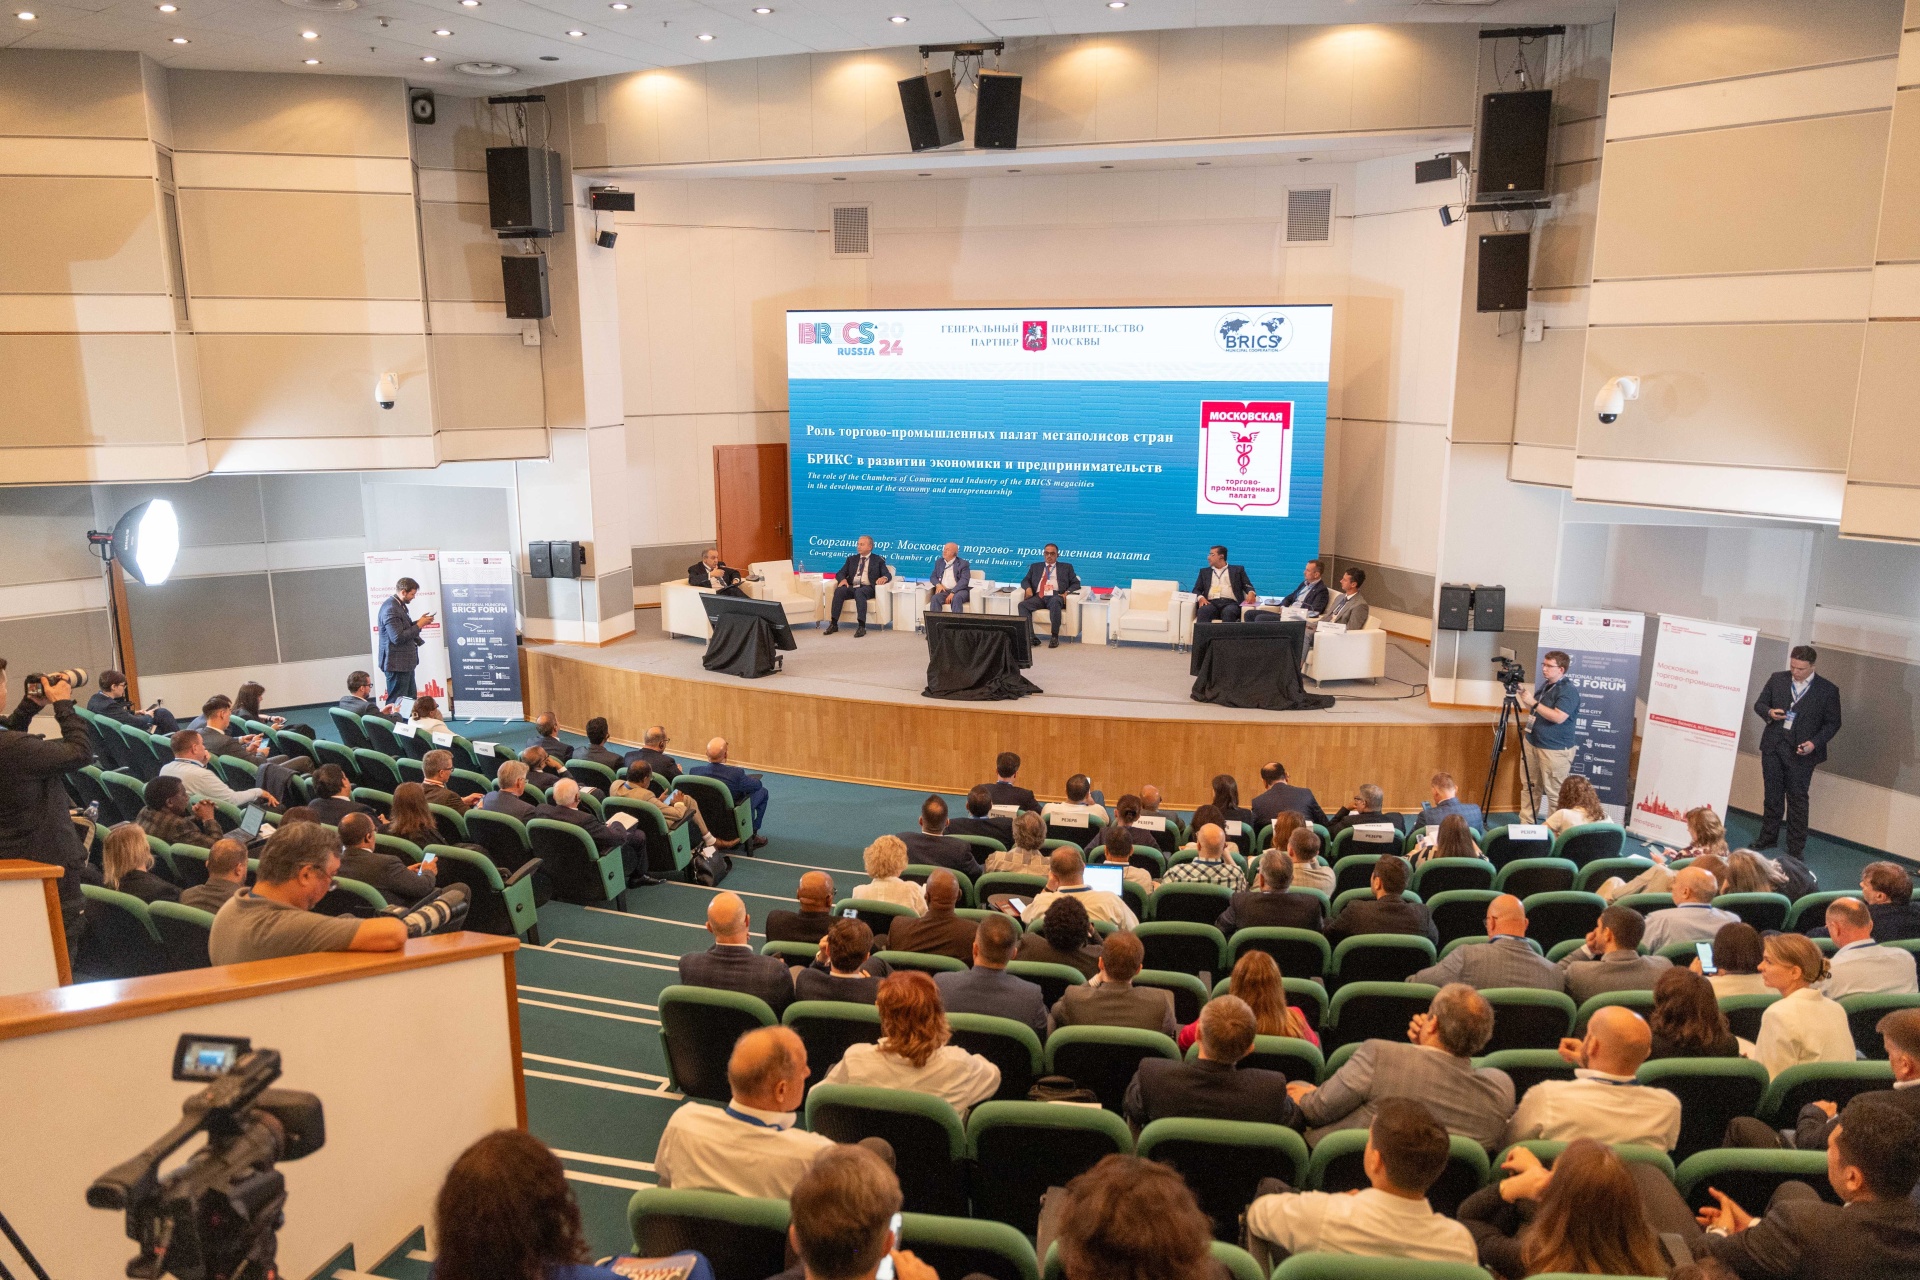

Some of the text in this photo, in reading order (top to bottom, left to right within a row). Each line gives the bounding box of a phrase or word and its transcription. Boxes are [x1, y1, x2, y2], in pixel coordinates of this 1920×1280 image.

[941, 322, 1019, 333] ГЕНЕРАЛЬНЫЙ
[1051, 324, 1144, 333] ПРАВИТЕЛЬСТВО
[971, 338, 1019, 347] ПАРТНЕР
[1051, 337, 1100, 346] МОСКВЫ
[1226, 335, 1279, 348] BRICS
[837, 347, 875, 356] RUSSIA
[879, 340, 904, 356] 24
[1209, 411, 1283, 421] МОСКОВСКАЯ
[806, 425, 1174, 445] Роль торгово-промышленных палат мегаполисов стран
[807, 453, 1163, 473] БРИКС в развитии экономики и предпринимательств
[807, 472, 821, 480] The
[822, 472, 837, 480] role
[838, 472, 848, 482] of
[848, 473, 859, 481] the
[861, 473, 897, 482] Chambers
[899, 474, 909, 484] of
[909, 475, 948, 483] Commerce
[949, 476, 965, 484] and
[965, 477, 998, 486] Industry
[1000, 478, 1010, 487] of
[1010, 478, 1022, 486] the
[1053, 480, 1095, 488] megacities
[816, 482, 828, 490] the
[829, 483, 874, 492] development
[875, 484, 885, 493] of
[885, 484, 897, 492] the
[898, 486, 931, 495] economy
[932, 486, 946, 494] and
[948, 487, 1013, 496] entrepreneurship
[1210, 485, 1276, 493] промышленная
[963, 545, 1014, 556] торгово-
[1106, 551, 1151, 561] палата
[890, 552, 923, 561] Chamber
[924, 554, 934, 564] of
[975, 557, 989, 565] and
[991, 557, 1024, 568] Industry
[1657, 662, 1699, 675] Московская
[1565, 673, 1593, 681] NATIONAL
[1656, 672, 1741, 692] торгово-промышленная
[1583, 680, 1627, 691] FORUM
[1654, 681, 1678, 690] палата
